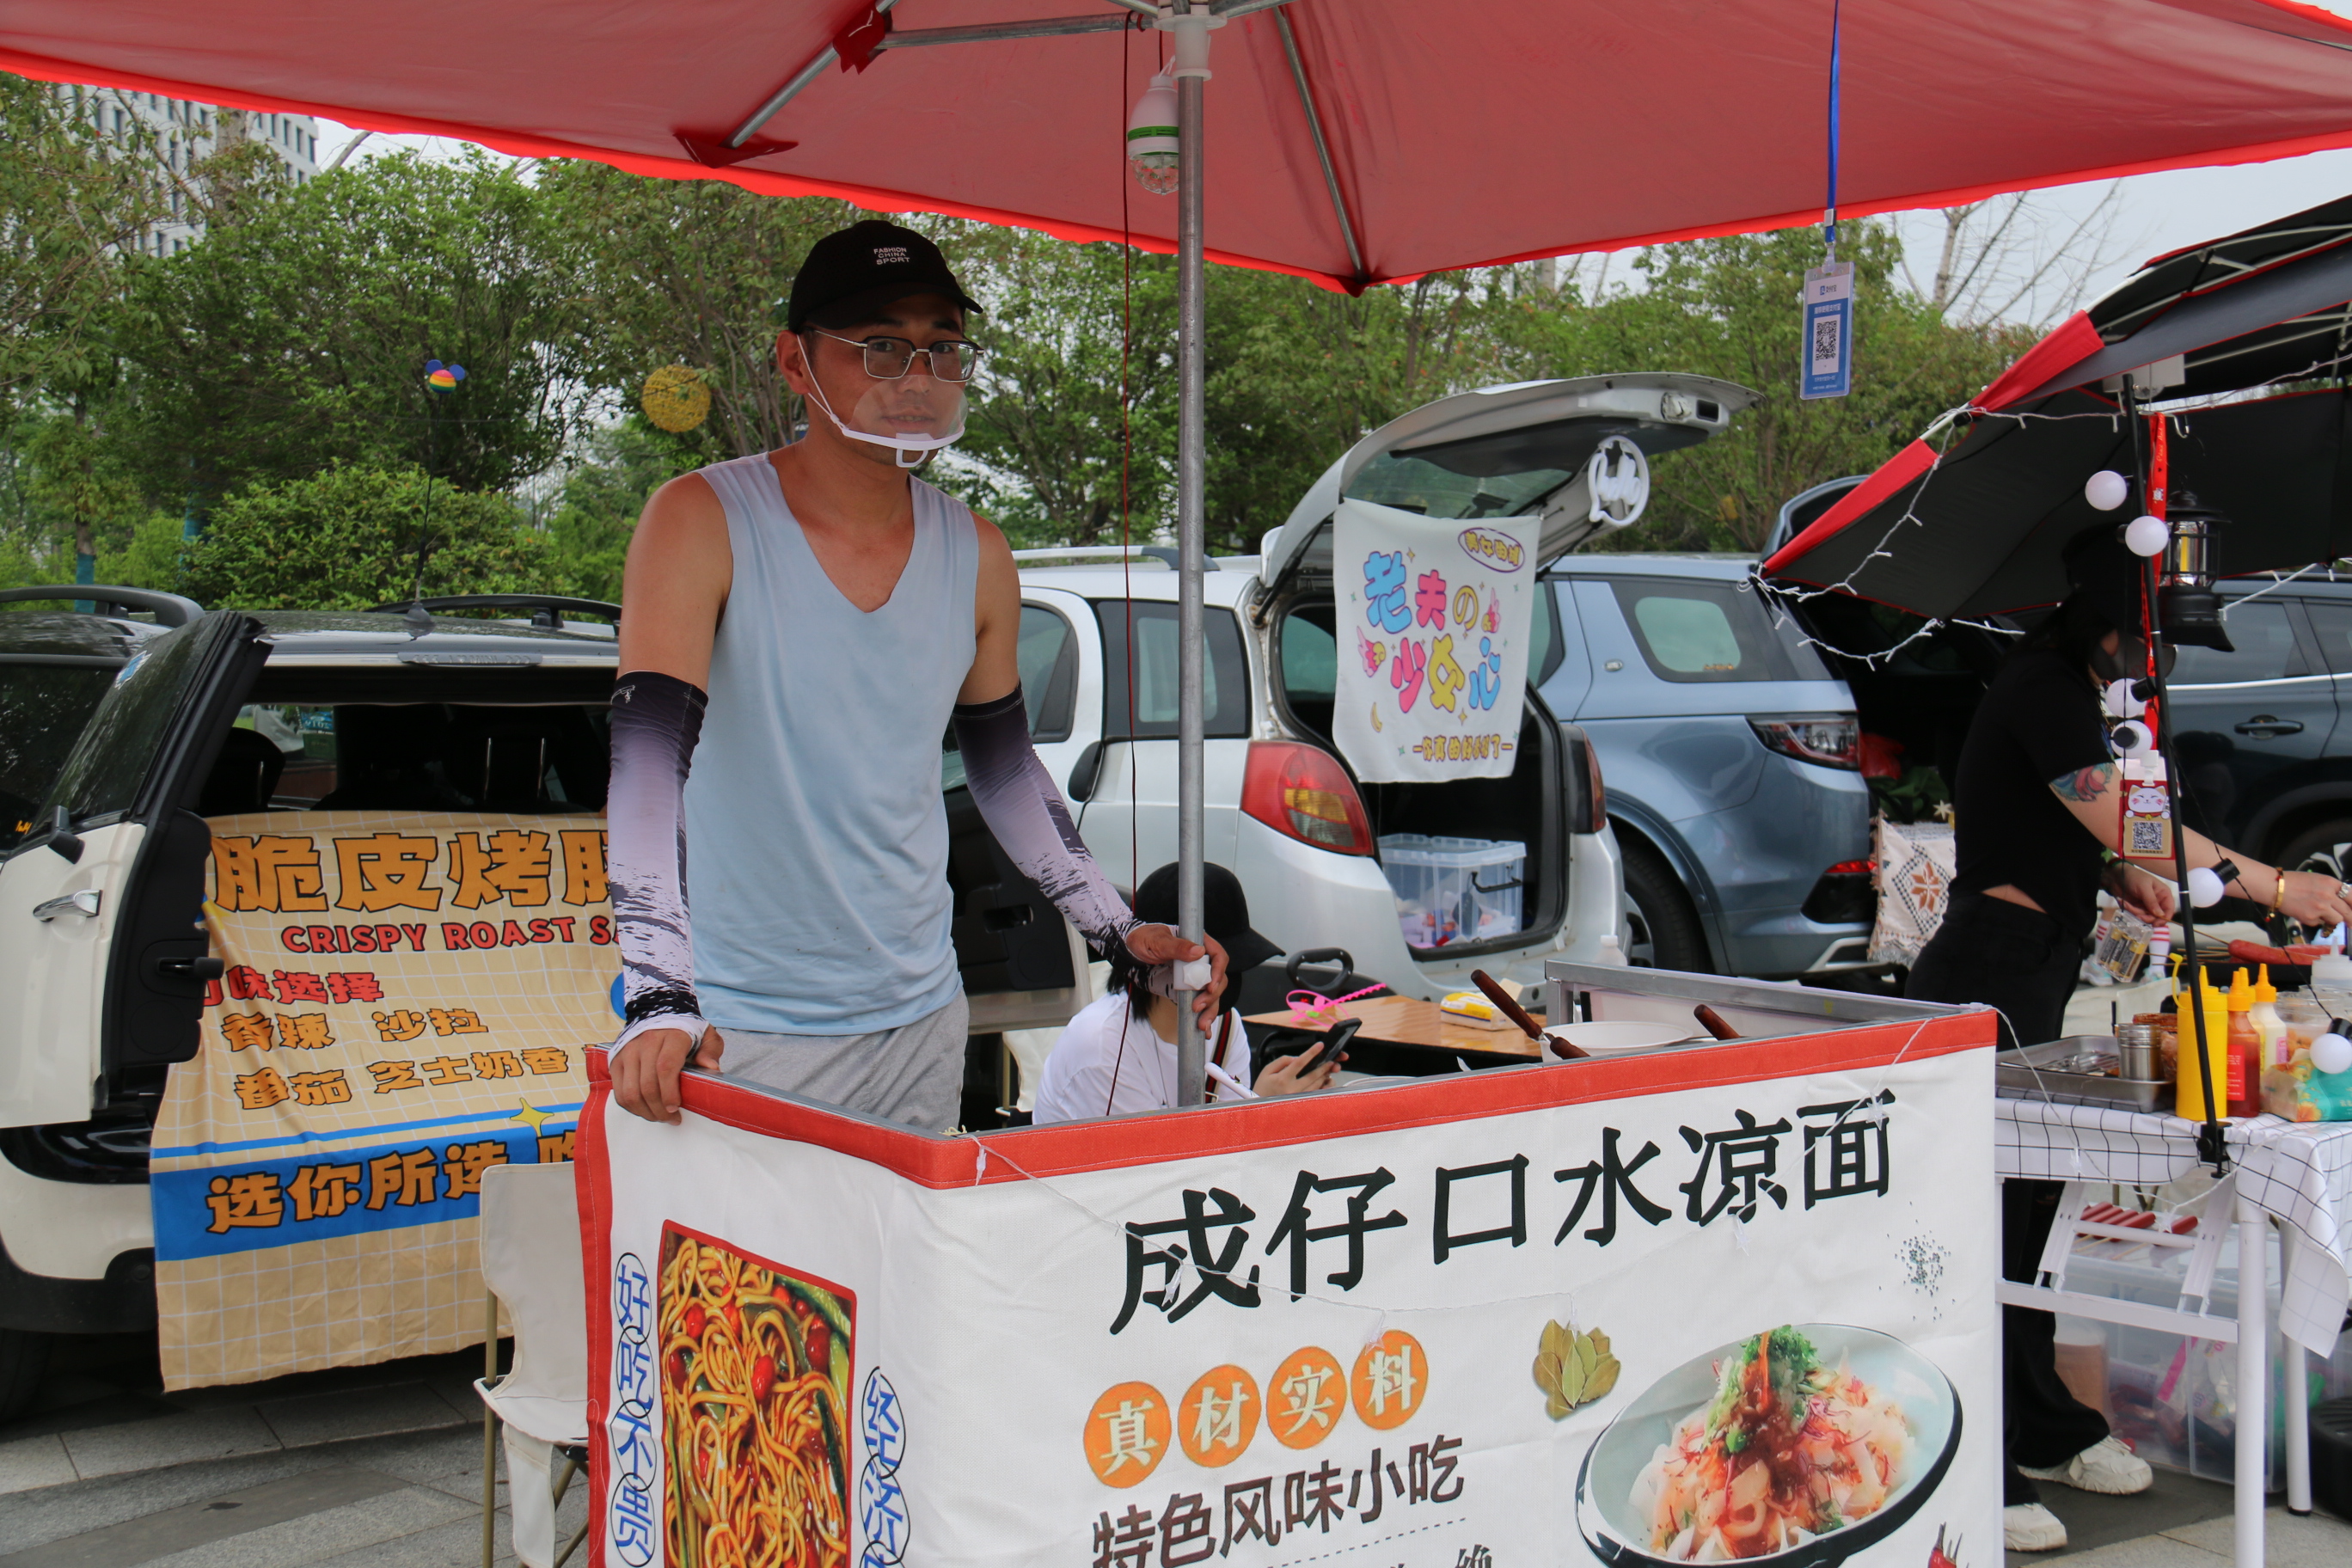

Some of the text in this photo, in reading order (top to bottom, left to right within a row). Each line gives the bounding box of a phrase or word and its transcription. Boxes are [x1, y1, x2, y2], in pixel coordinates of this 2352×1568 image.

[1390, 634, 1501, 713] 少女心
[281, 922, 428, 954] CRISPY
[441, 916, 576, 951] ROAST
[221, 1008, 489, 1052] 香辣 沙拉
[234, 1046, 569, 1110] 番茄 芝士奶香
[1109, 1088, 1896, 1335] 成仔口水凉面
[614, 1262, 654, 1561] 好吃不贵
[861, 1375, 905, 1568] 经济
[1098, 1344, 1418, 1477] 真材实料
[1092, 1435, 1466, 1568] 特色风味小吃
